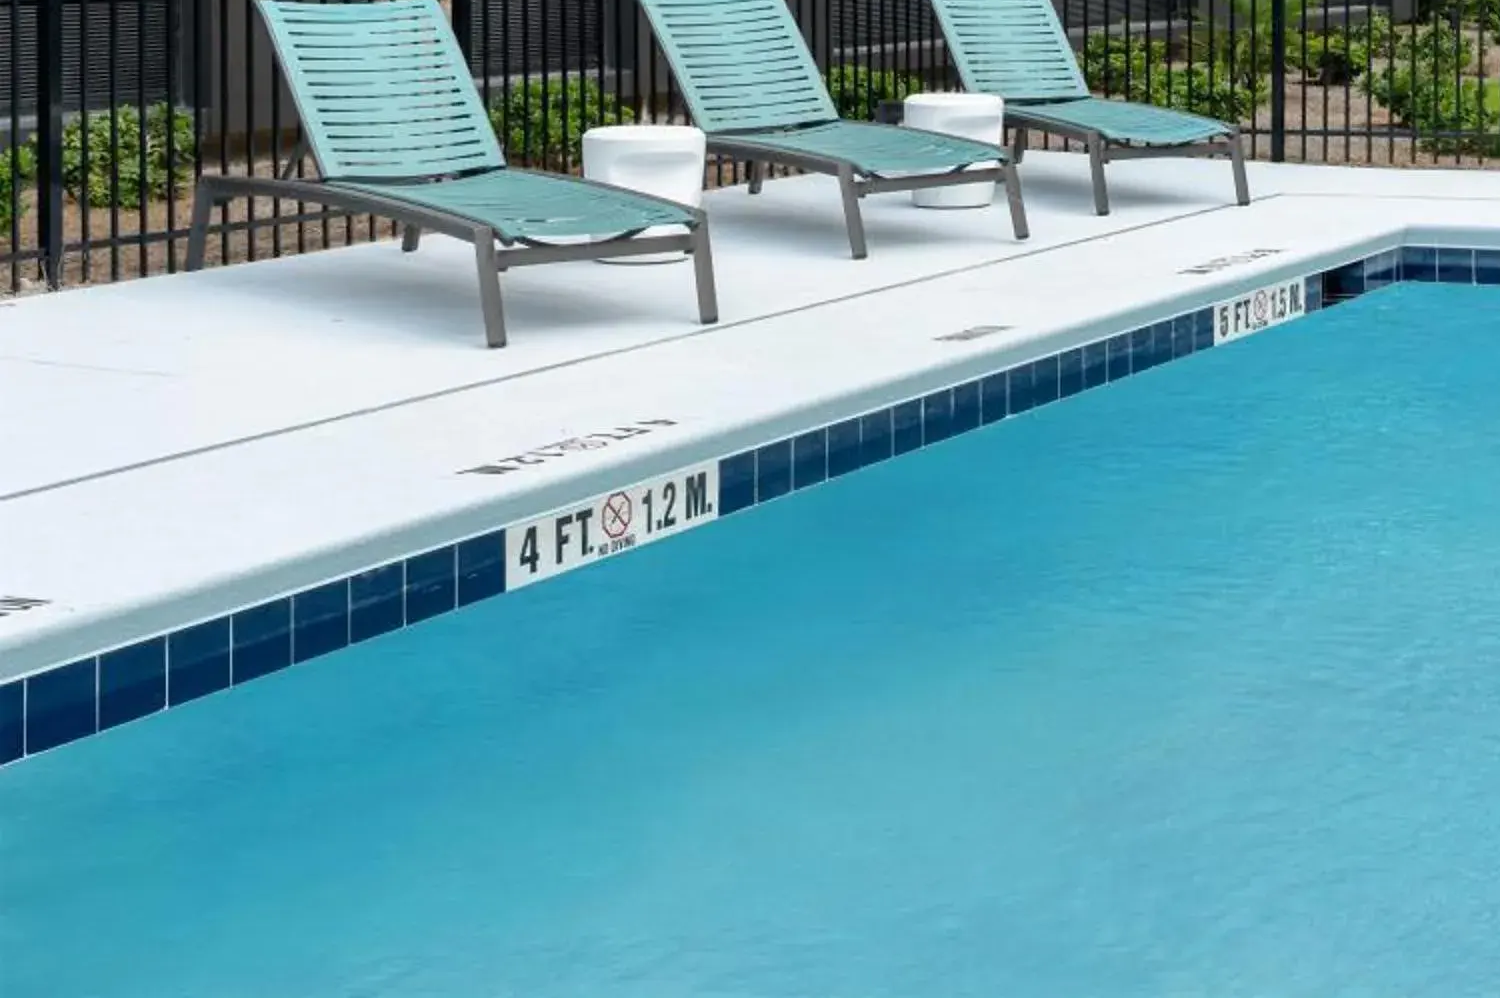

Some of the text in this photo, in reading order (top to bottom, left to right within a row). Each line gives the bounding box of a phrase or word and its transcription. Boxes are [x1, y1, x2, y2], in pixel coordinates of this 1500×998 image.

[1219, 306, 1229, 338] 5
[518, 471, 713, 574] 4 FT. 1.2 M.
